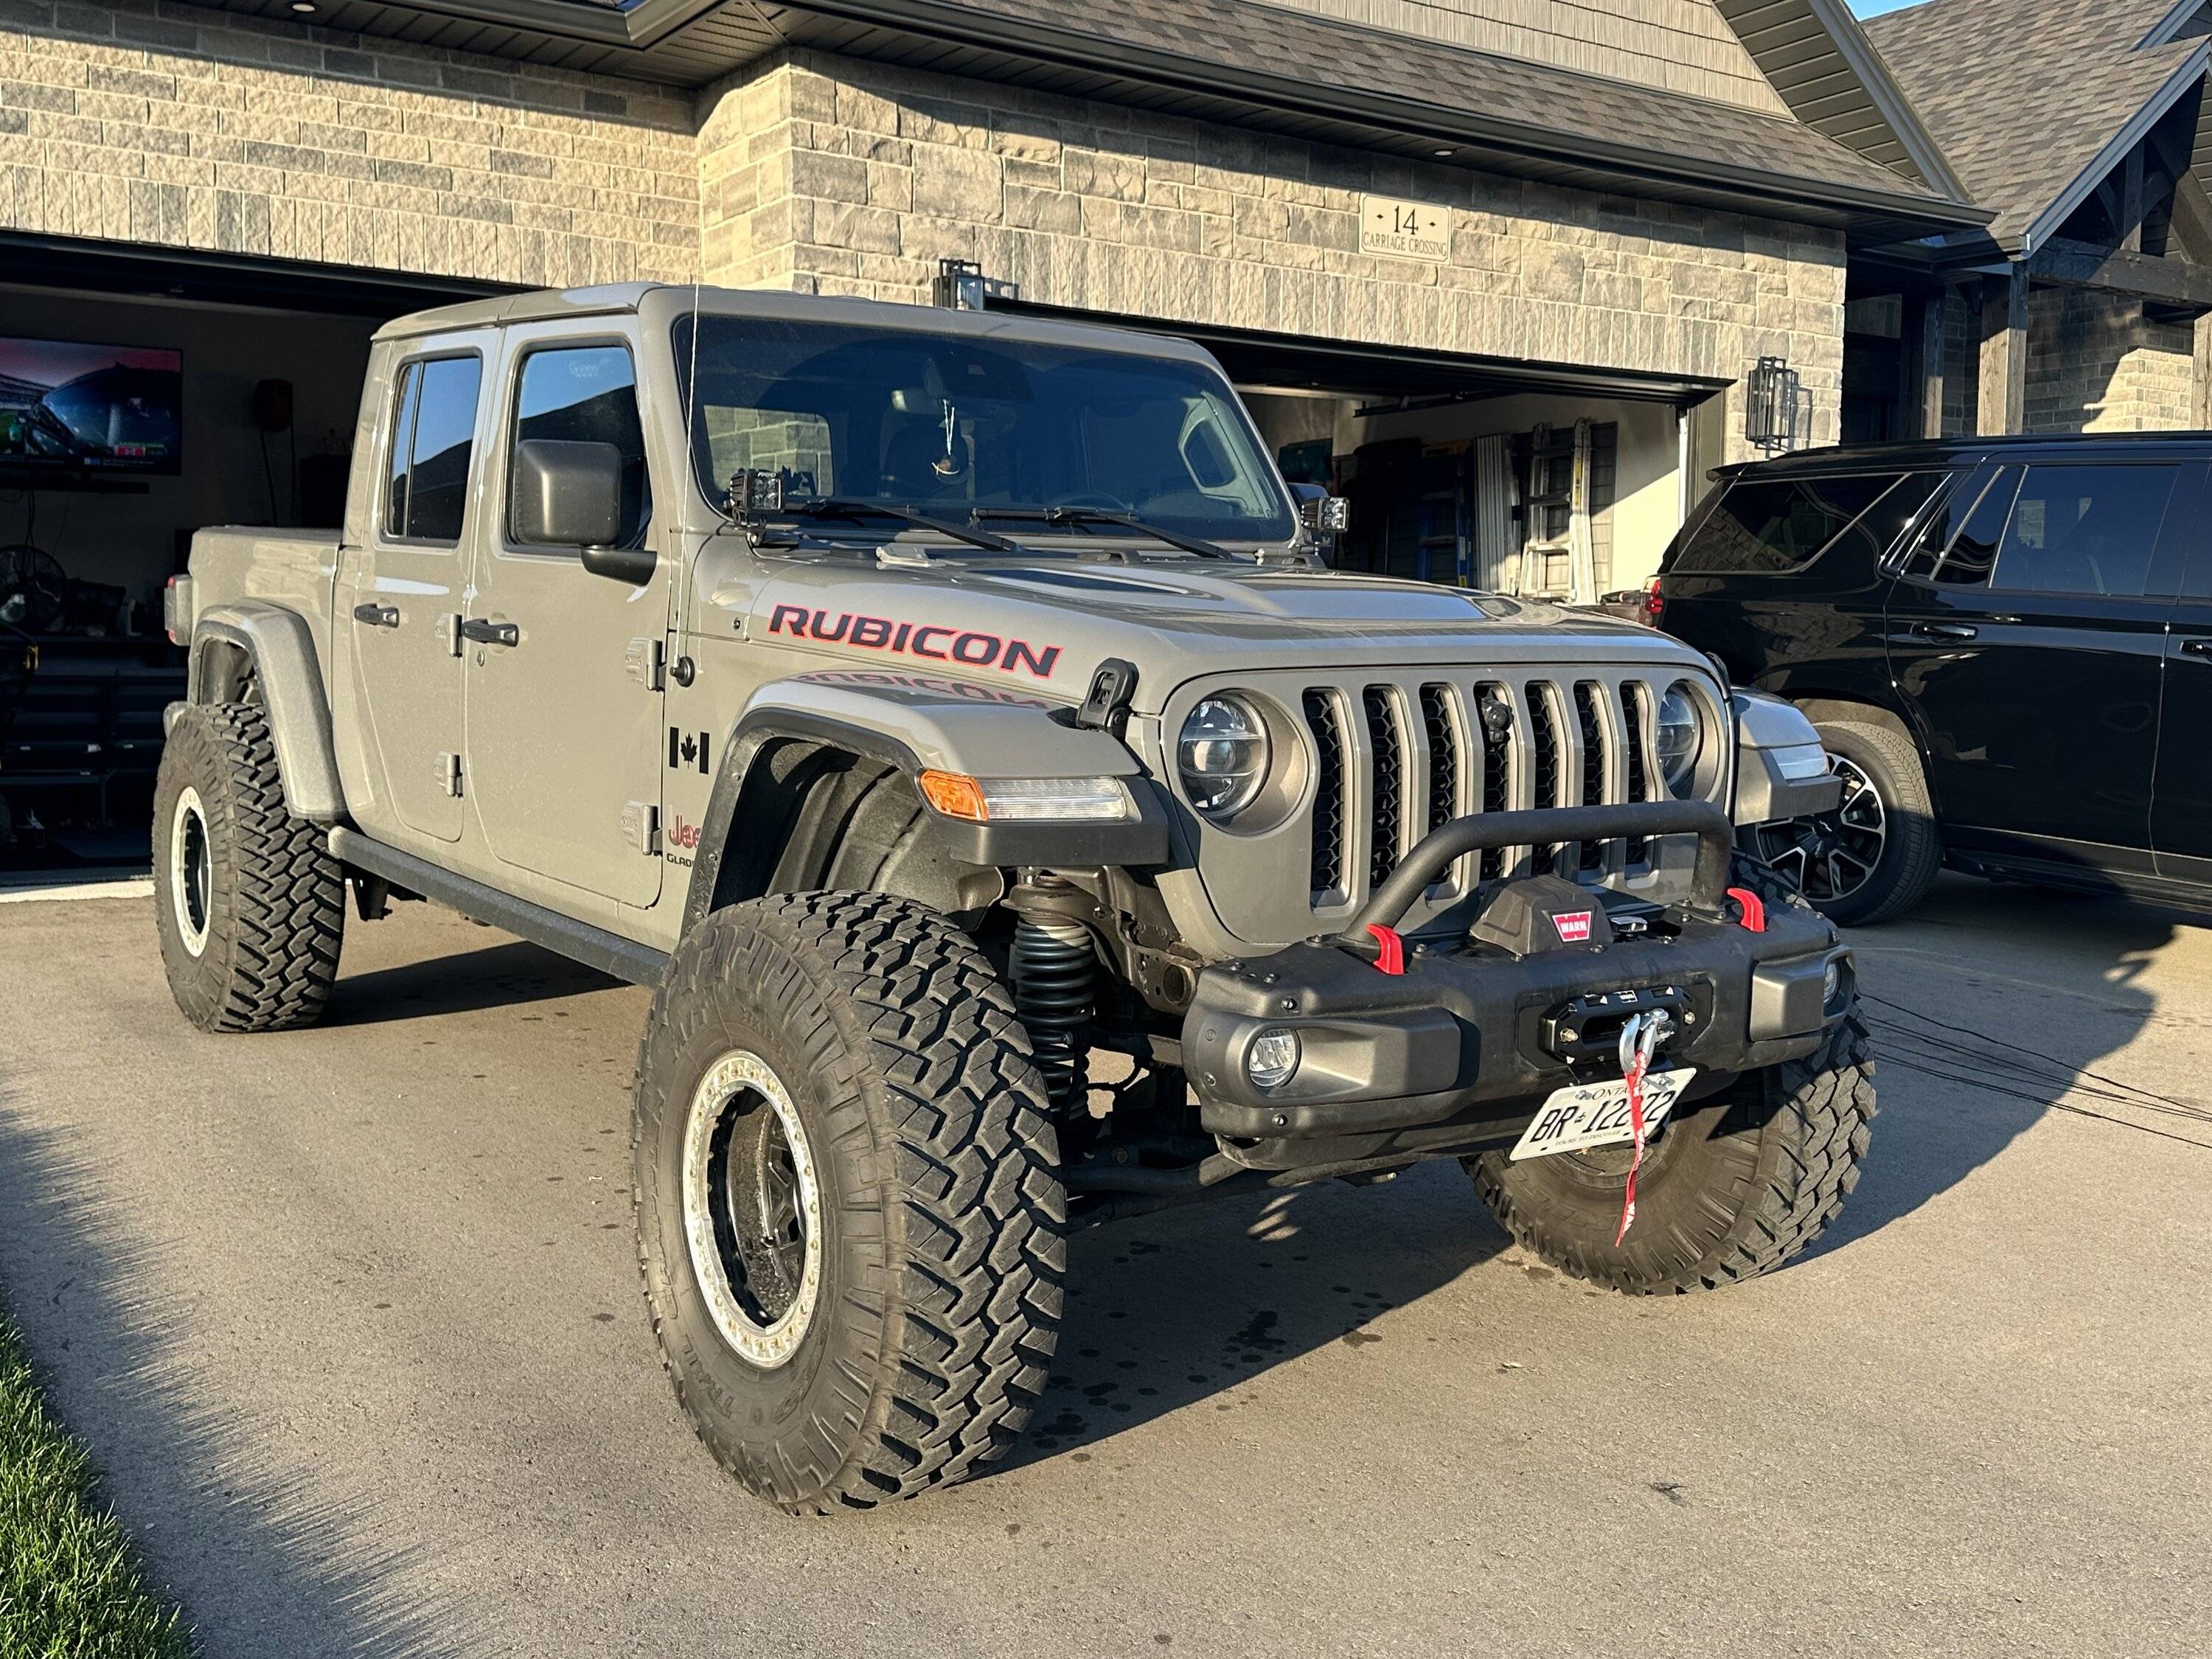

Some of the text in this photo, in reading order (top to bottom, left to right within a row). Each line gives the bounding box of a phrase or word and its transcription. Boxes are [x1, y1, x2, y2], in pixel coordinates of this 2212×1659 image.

[1393, 205, 1419, 235] 14
[1363, 232, 1447, 257] CARRIAGE CROSSING
[768, 603, 1064, 679] RUBICON
[668, 815, 702, 849] Jee
[667, 852, 693, 868] GLAD
[1560, 920, 1587, 933] WARN
[1592, 1082, 1650, 1100] ONTAO
[1530, 1105, 1580, 1143] BR
